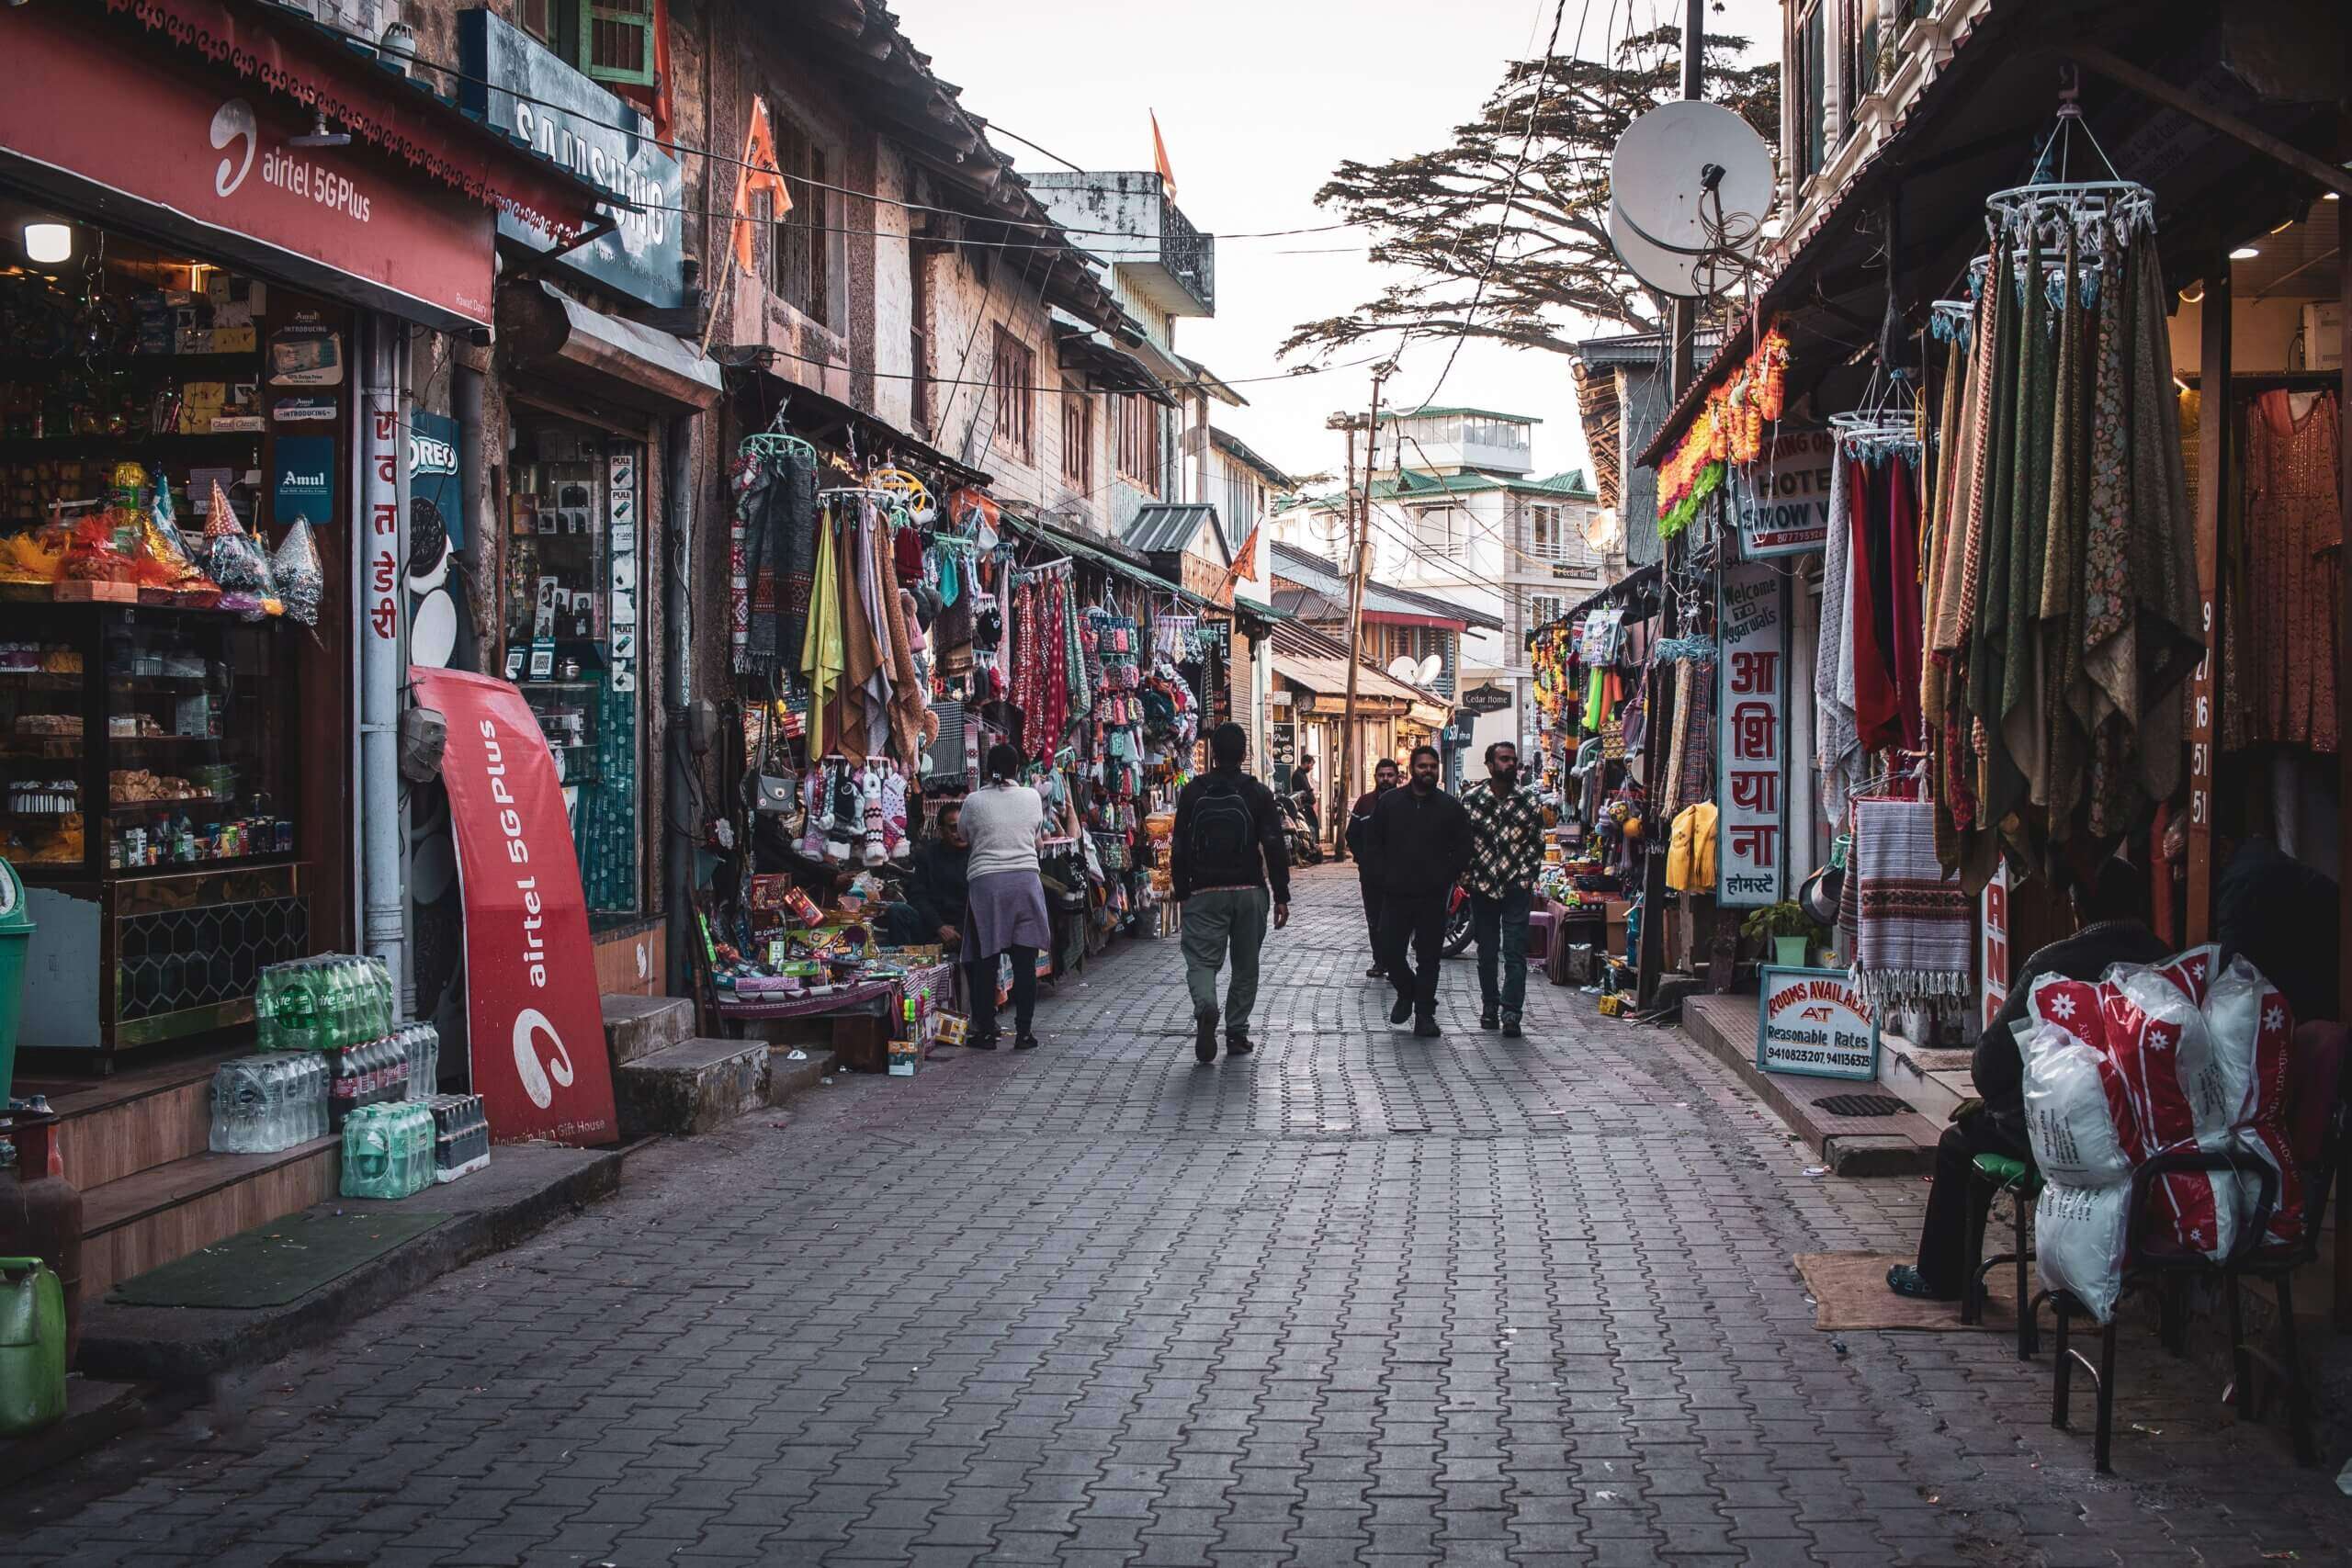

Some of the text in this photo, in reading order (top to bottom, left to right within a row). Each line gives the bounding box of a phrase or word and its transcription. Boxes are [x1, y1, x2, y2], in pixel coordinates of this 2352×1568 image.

[263, 146, 371, 223] airtel 5GPlus
[516, 101, 664, 246] SAMSUNG
[456, 292, 487, 318] Rawat Dairy
[612, 457, 631, 465] PULL
[282, 469, 325, 486] Amul
[1758, 468, 1832, 499] HOTE
[1742, 502, 1810, 531] SNOW
[1724, 579, 1777, 606] Welcome
[2203, 602, 2211, 632] 9
[1465, 695, 1508, 704] Cedar Home
[2195, 695, 2209, 728] 16
[1729, 650, 1780, 868] आशियाना
[2193, 742, 2208, 776] 51
[480, 718, 529, 864] 5GPlus
[2192, 789, 2207, 824] 51
[515, 874, 545, 988] airtel
[1768, 982, 1808, 1021] ROOMS
[1800, 1006, 1834, 1023] AT
[1767, 1024, 1869, 1049] Reasonable Rates
[557, 1120, 574, 1138] Gift
[576, 1118, 605, 1134] House
